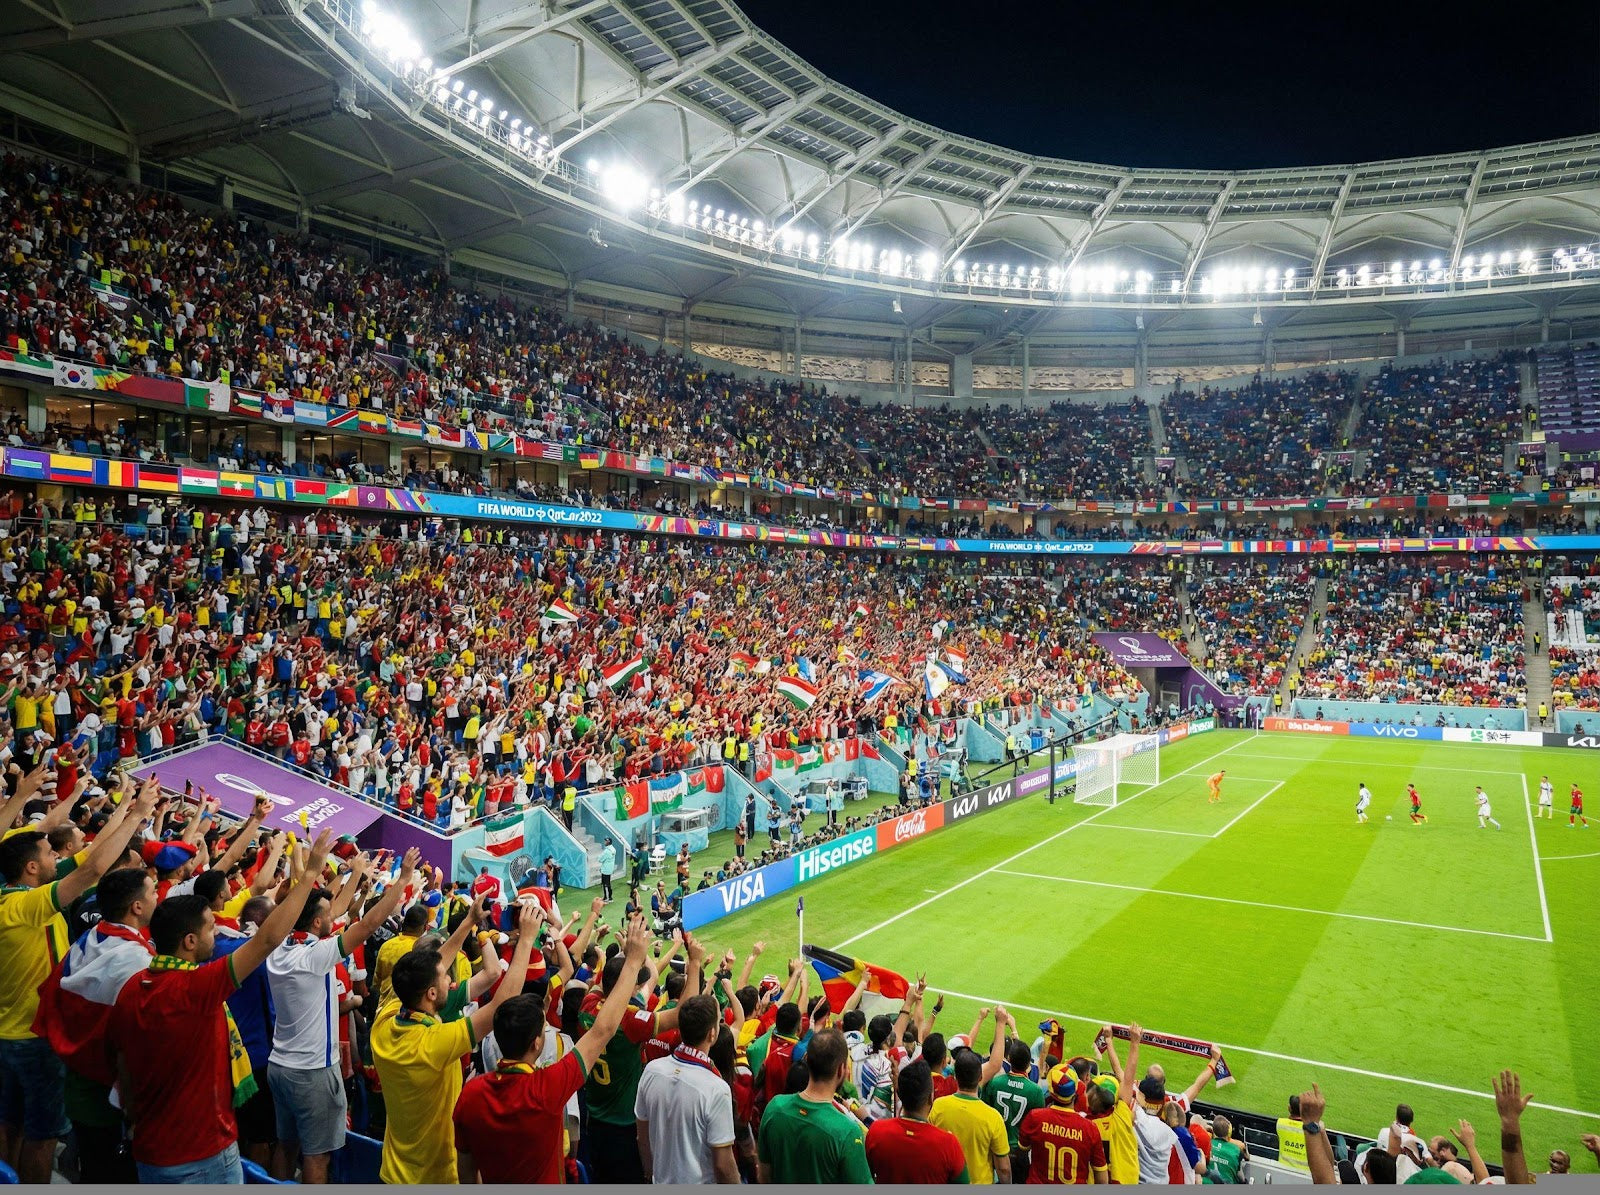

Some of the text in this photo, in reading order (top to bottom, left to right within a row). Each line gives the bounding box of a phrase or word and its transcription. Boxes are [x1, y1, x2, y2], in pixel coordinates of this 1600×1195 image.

[478, 503, 499, 515] FIFA
[500, 504, 535, 518] WORLD
[1373, 725, 1419, 738] vivo
[799, 834, 874, 882] Hisense
[717, 871, 765, 912] VISA
[997, 1090, 1028, 1126] 57
[1044, 1141, 1078, 1184] 10
